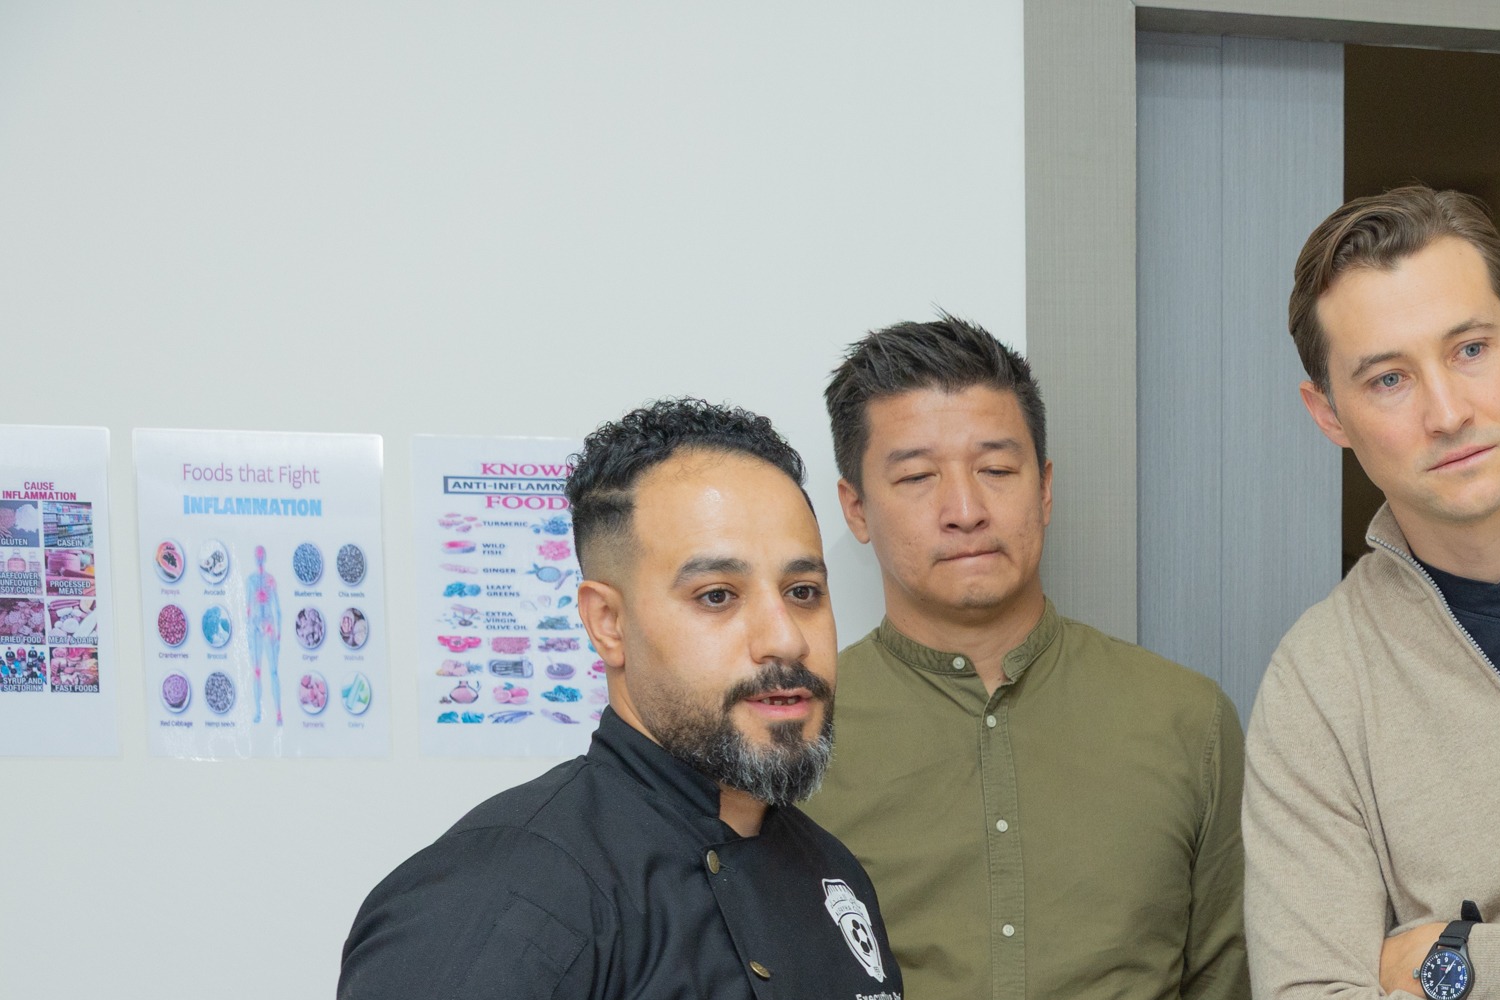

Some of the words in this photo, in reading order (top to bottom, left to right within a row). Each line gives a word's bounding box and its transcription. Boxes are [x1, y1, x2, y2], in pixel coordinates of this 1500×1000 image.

[183, 462, 233, 482] Foods
[238, 463, 274, 483] that
[279, 465, 321, 490] Fight
[24, 481, 54, 491] CAUSE
[2, 491, 77, 501] INFLAMMATION
[485, 496, 572, 510] FOOD
[1, 538, 28, 546] GLUTEN
[57, 539, 83, 547] CASEIN
[0, 579, 38, 587] UNFLOWER
[50, 580, 91, 588] PROCESSED
[1, 635, 21, 644] FRIED
[23, 635, 42, 644] FOOD
[48, 636, 69, 645] MEAT
[76, 637, 98, 645] DAIRY
[28, 677, 43, 685] AND
[55, 684, 73, 692] FAST
[75, 684, 98, 692] FOODS
